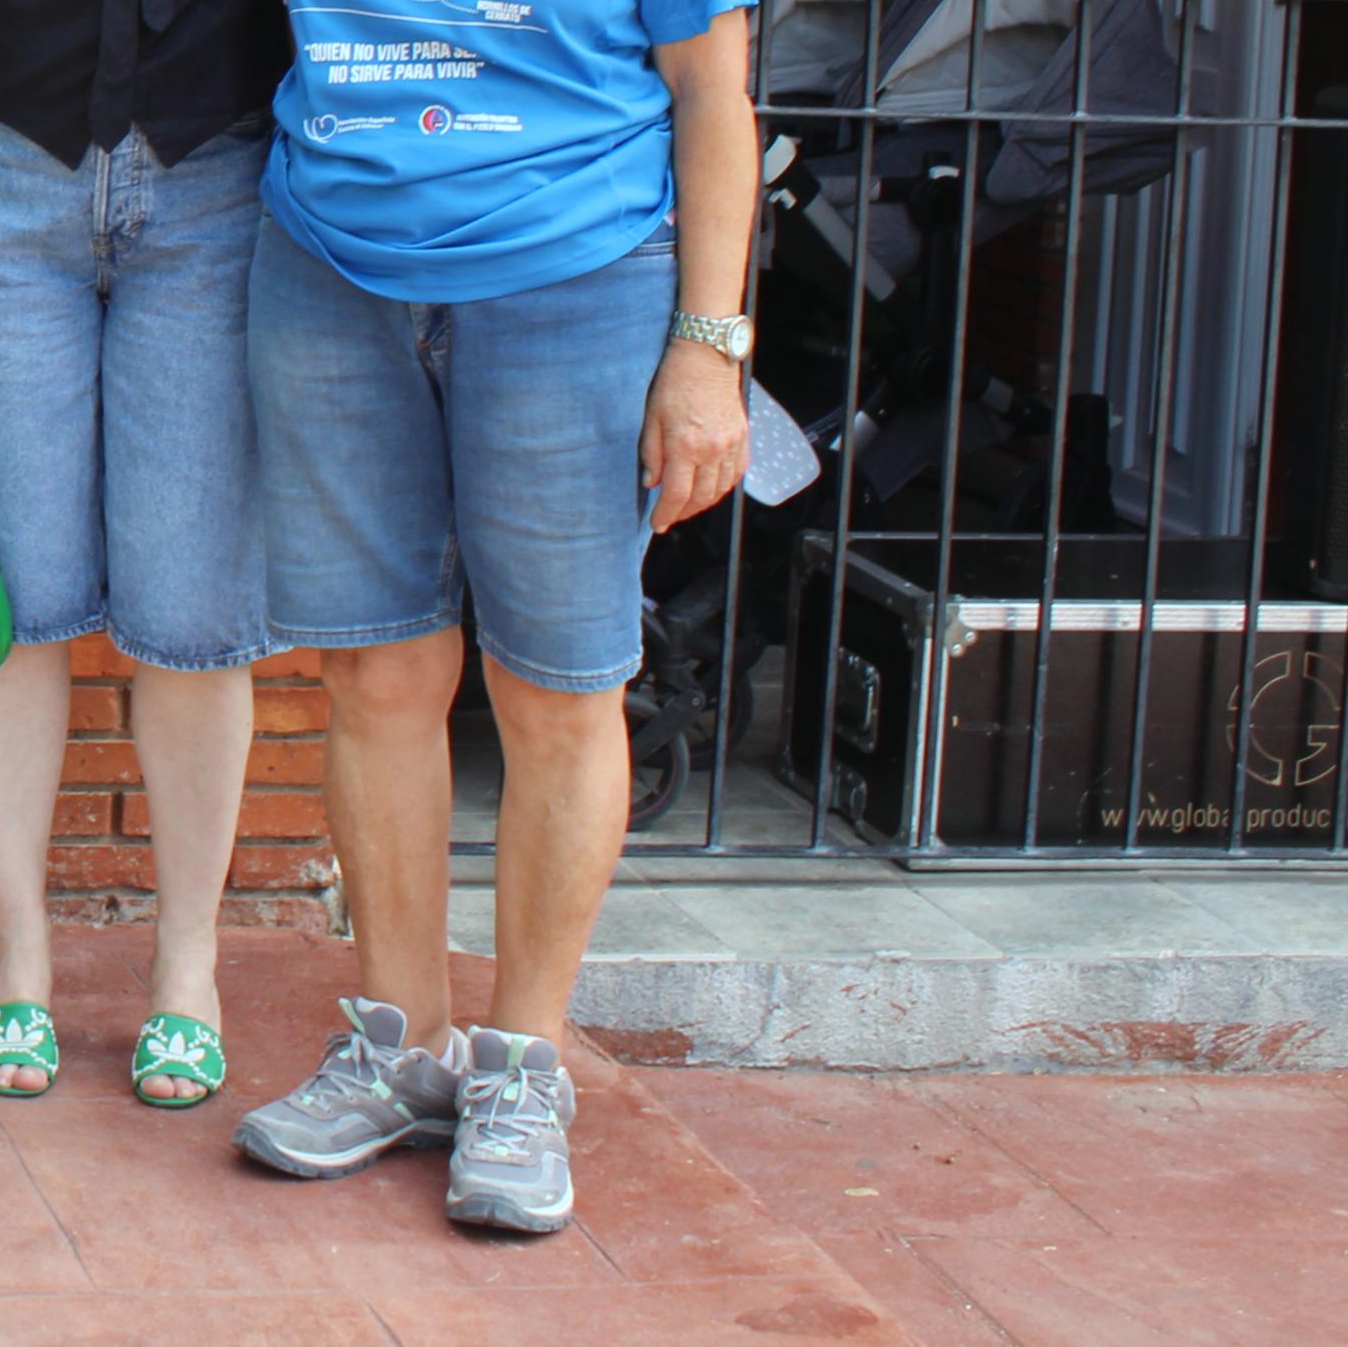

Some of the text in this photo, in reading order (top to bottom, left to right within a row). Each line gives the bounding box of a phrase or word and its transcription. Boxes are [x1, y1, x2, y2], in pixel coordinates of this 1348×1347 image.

[353, 43, 375, 62] NO
[377, 43, 410, 62] VIVE
[412, 41, 451, 61] PARA
[328, 64, 348, 85] NO
[350, 63, 393, 84] SIRVE
[394, 62, 433, 81] PARA
